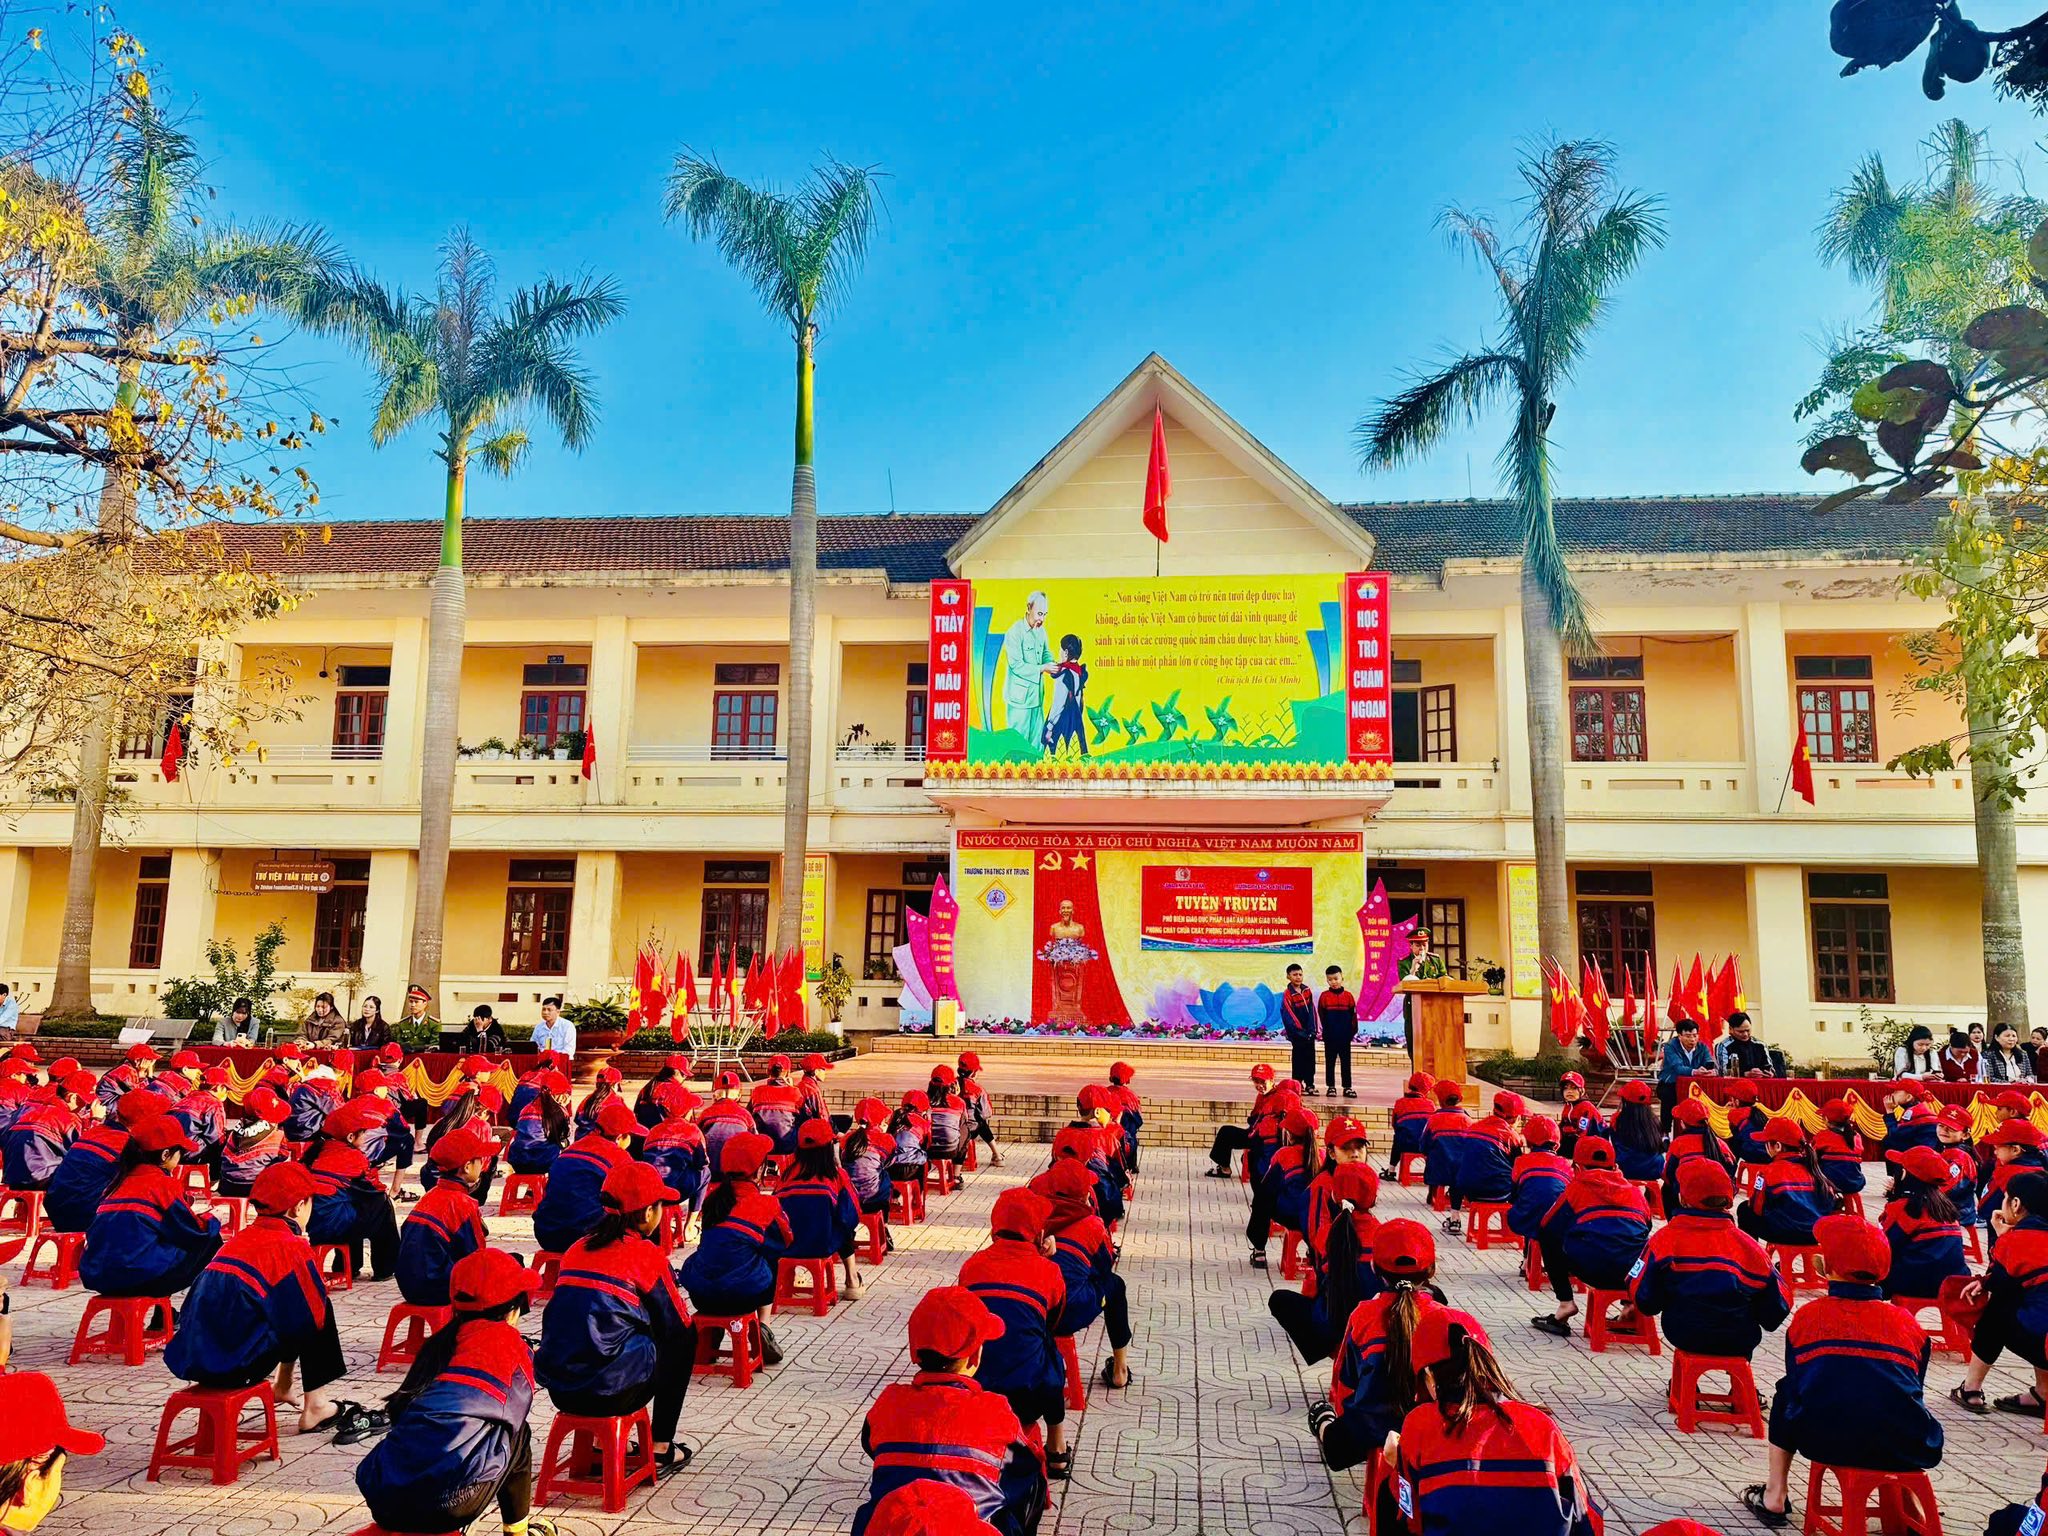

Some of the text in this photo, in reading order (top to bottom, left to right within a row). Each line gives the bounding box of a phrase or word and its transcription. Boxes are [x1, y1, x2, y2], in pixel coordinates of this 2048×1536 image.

[934, 609, 965, 633] THẦY
[1357, 610, 1379, 631] HỌC
[941, 641, 957, 662] CÔ
[1358, 637, 1378, 658] TRÒ
[1353, 667, 1383, 688] CHĂM
[934, 700, 961, 723] MỰC
[1351, 701, 1386, 718] NGOAN
[964, 833, 1355, 850] NƯỚC CỘNG HÒA XÃ HỘI CHỦ NGHĨA VIỆT NAM MUÔN NĂM
[255, 871, 319, 882] THƯ VIỆN THÂN THIỆN
[1176, 892, 1278, 911] TUYÊN TRUYỀN
